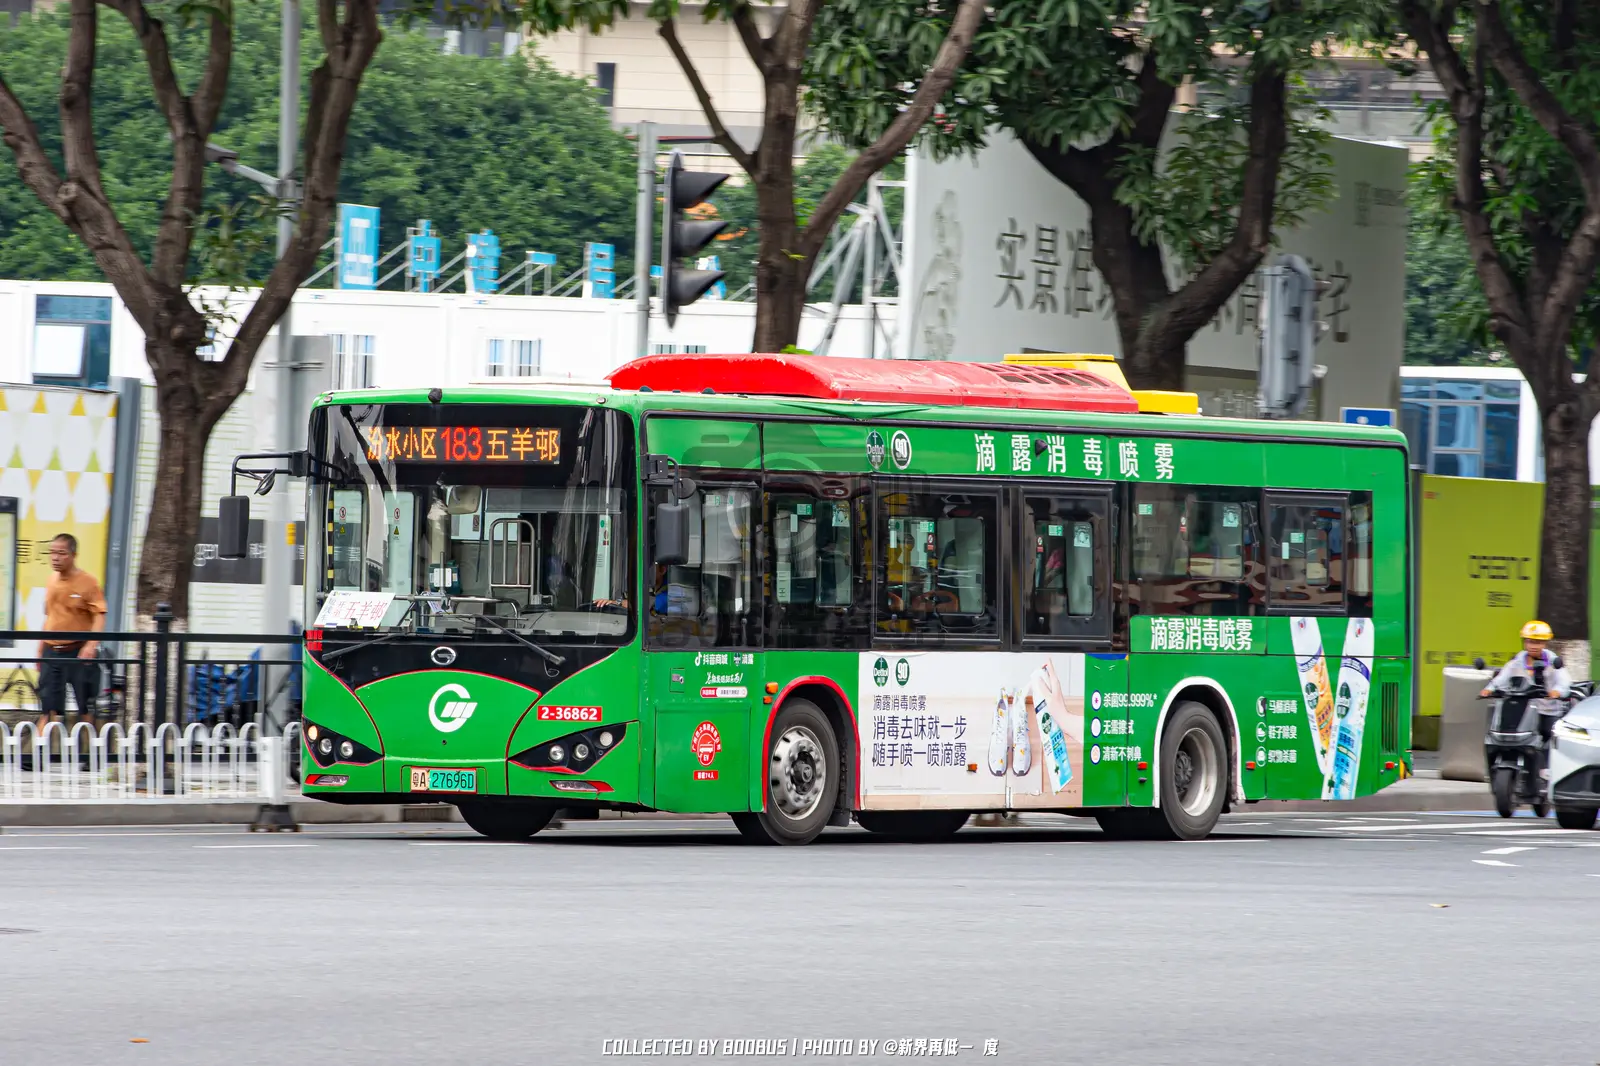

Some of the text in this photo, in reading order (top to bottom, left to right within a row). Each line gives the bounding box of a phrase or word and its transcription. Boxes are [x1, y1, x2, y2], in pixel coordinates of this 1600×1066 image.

[440, 426, 483, 461] 183
[486, 427, 559, 461] 五羊邨
[894, 438, 908, 459] 90
[974, 432, 1175, 480] 滴露消毒喷雾
[1150, 616, 1253, 651] 滴露消毒喷雾
[896, 661, 908, 680] 90
[541, 706, 598, 721] 2-36862
[872, 694, 927, 712] 滴露消毒喷雾
[872, 715, 968, 741] 消毒去味就一步
[872, 742, 968, 768] 随手喷一喷滴露
